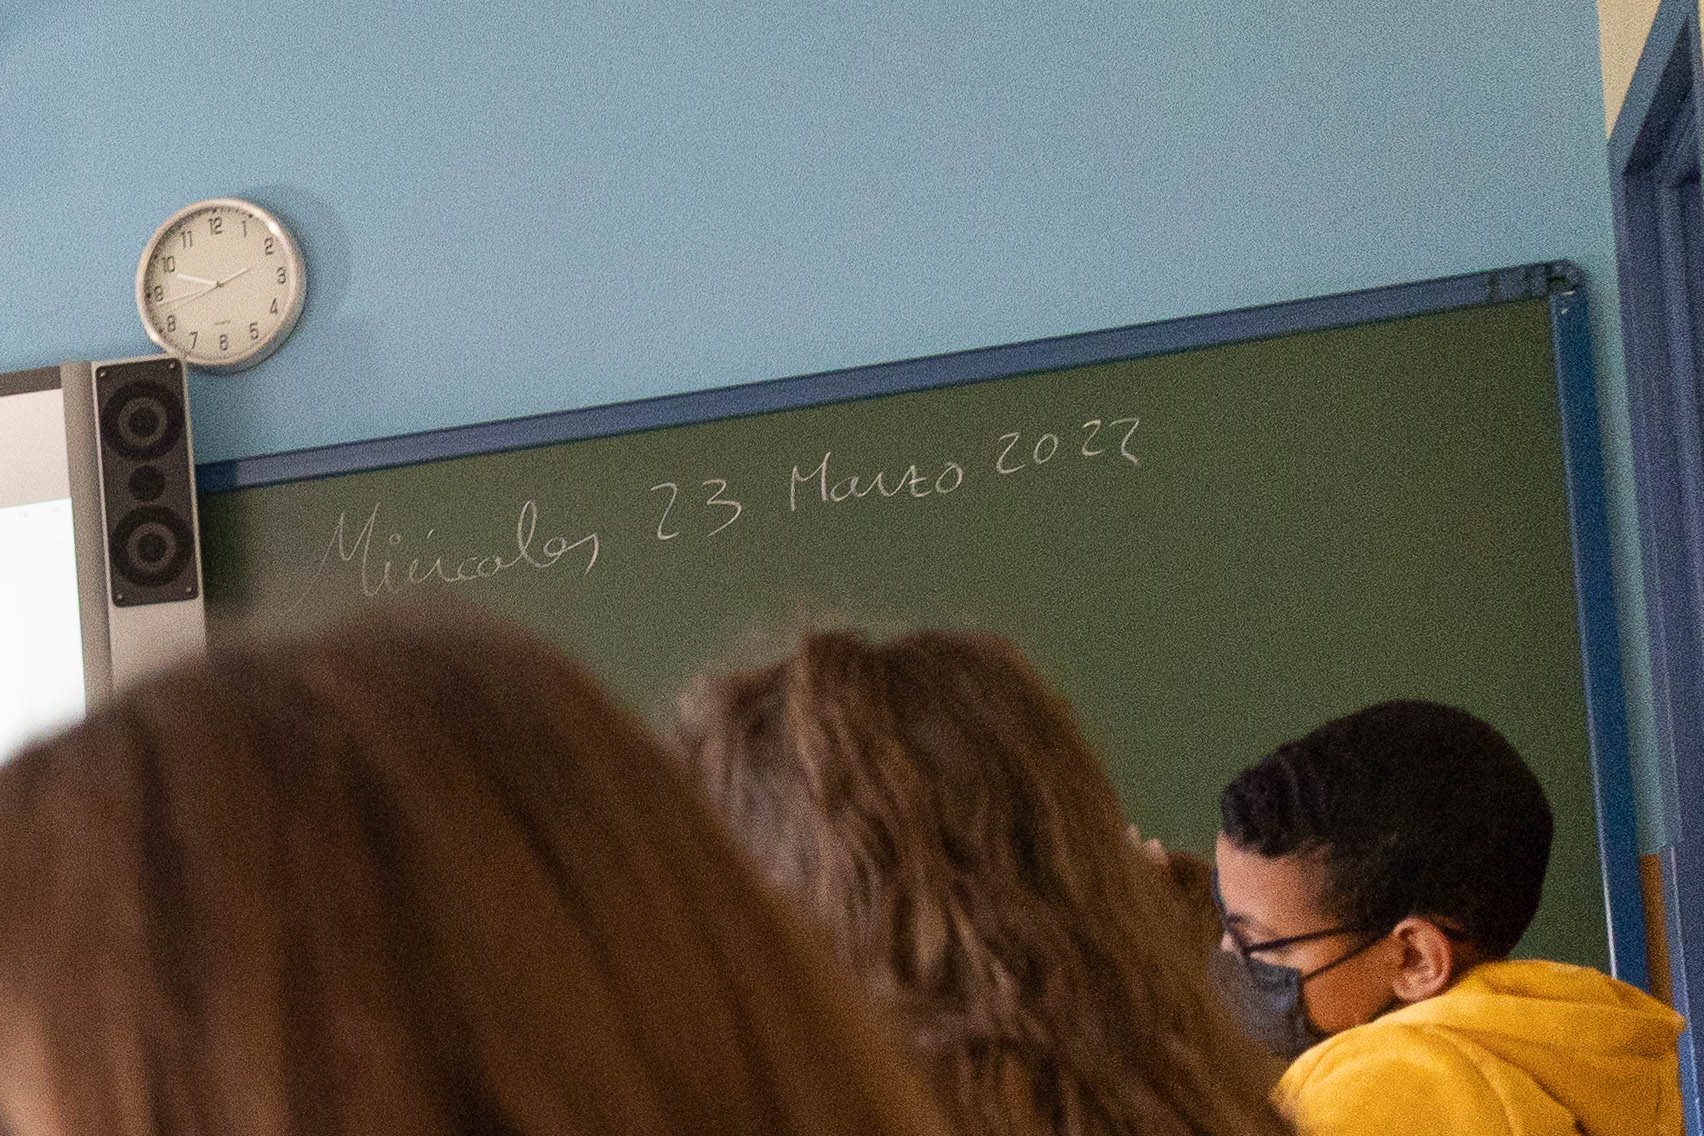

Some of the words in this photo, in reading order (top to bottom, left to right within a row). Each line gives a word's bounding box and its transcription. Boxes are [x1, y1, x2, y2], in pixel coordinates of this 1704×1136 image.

[208, 216, 223, 235] 12
[181, 230, 193, 249] 11
[264, 237, 274, 256] 2
[162, 255, 176, 274] 10
[277, 266, 287, 284] 3
[269, 298, 279, 315] 4
[166, 314, 177, 333] 8
[249, 322, 259, 340] 5
[189, 331, 199, 350] 7
[650, 478, 743, 540] 23
[789, 451, 963, 513] Marzo
